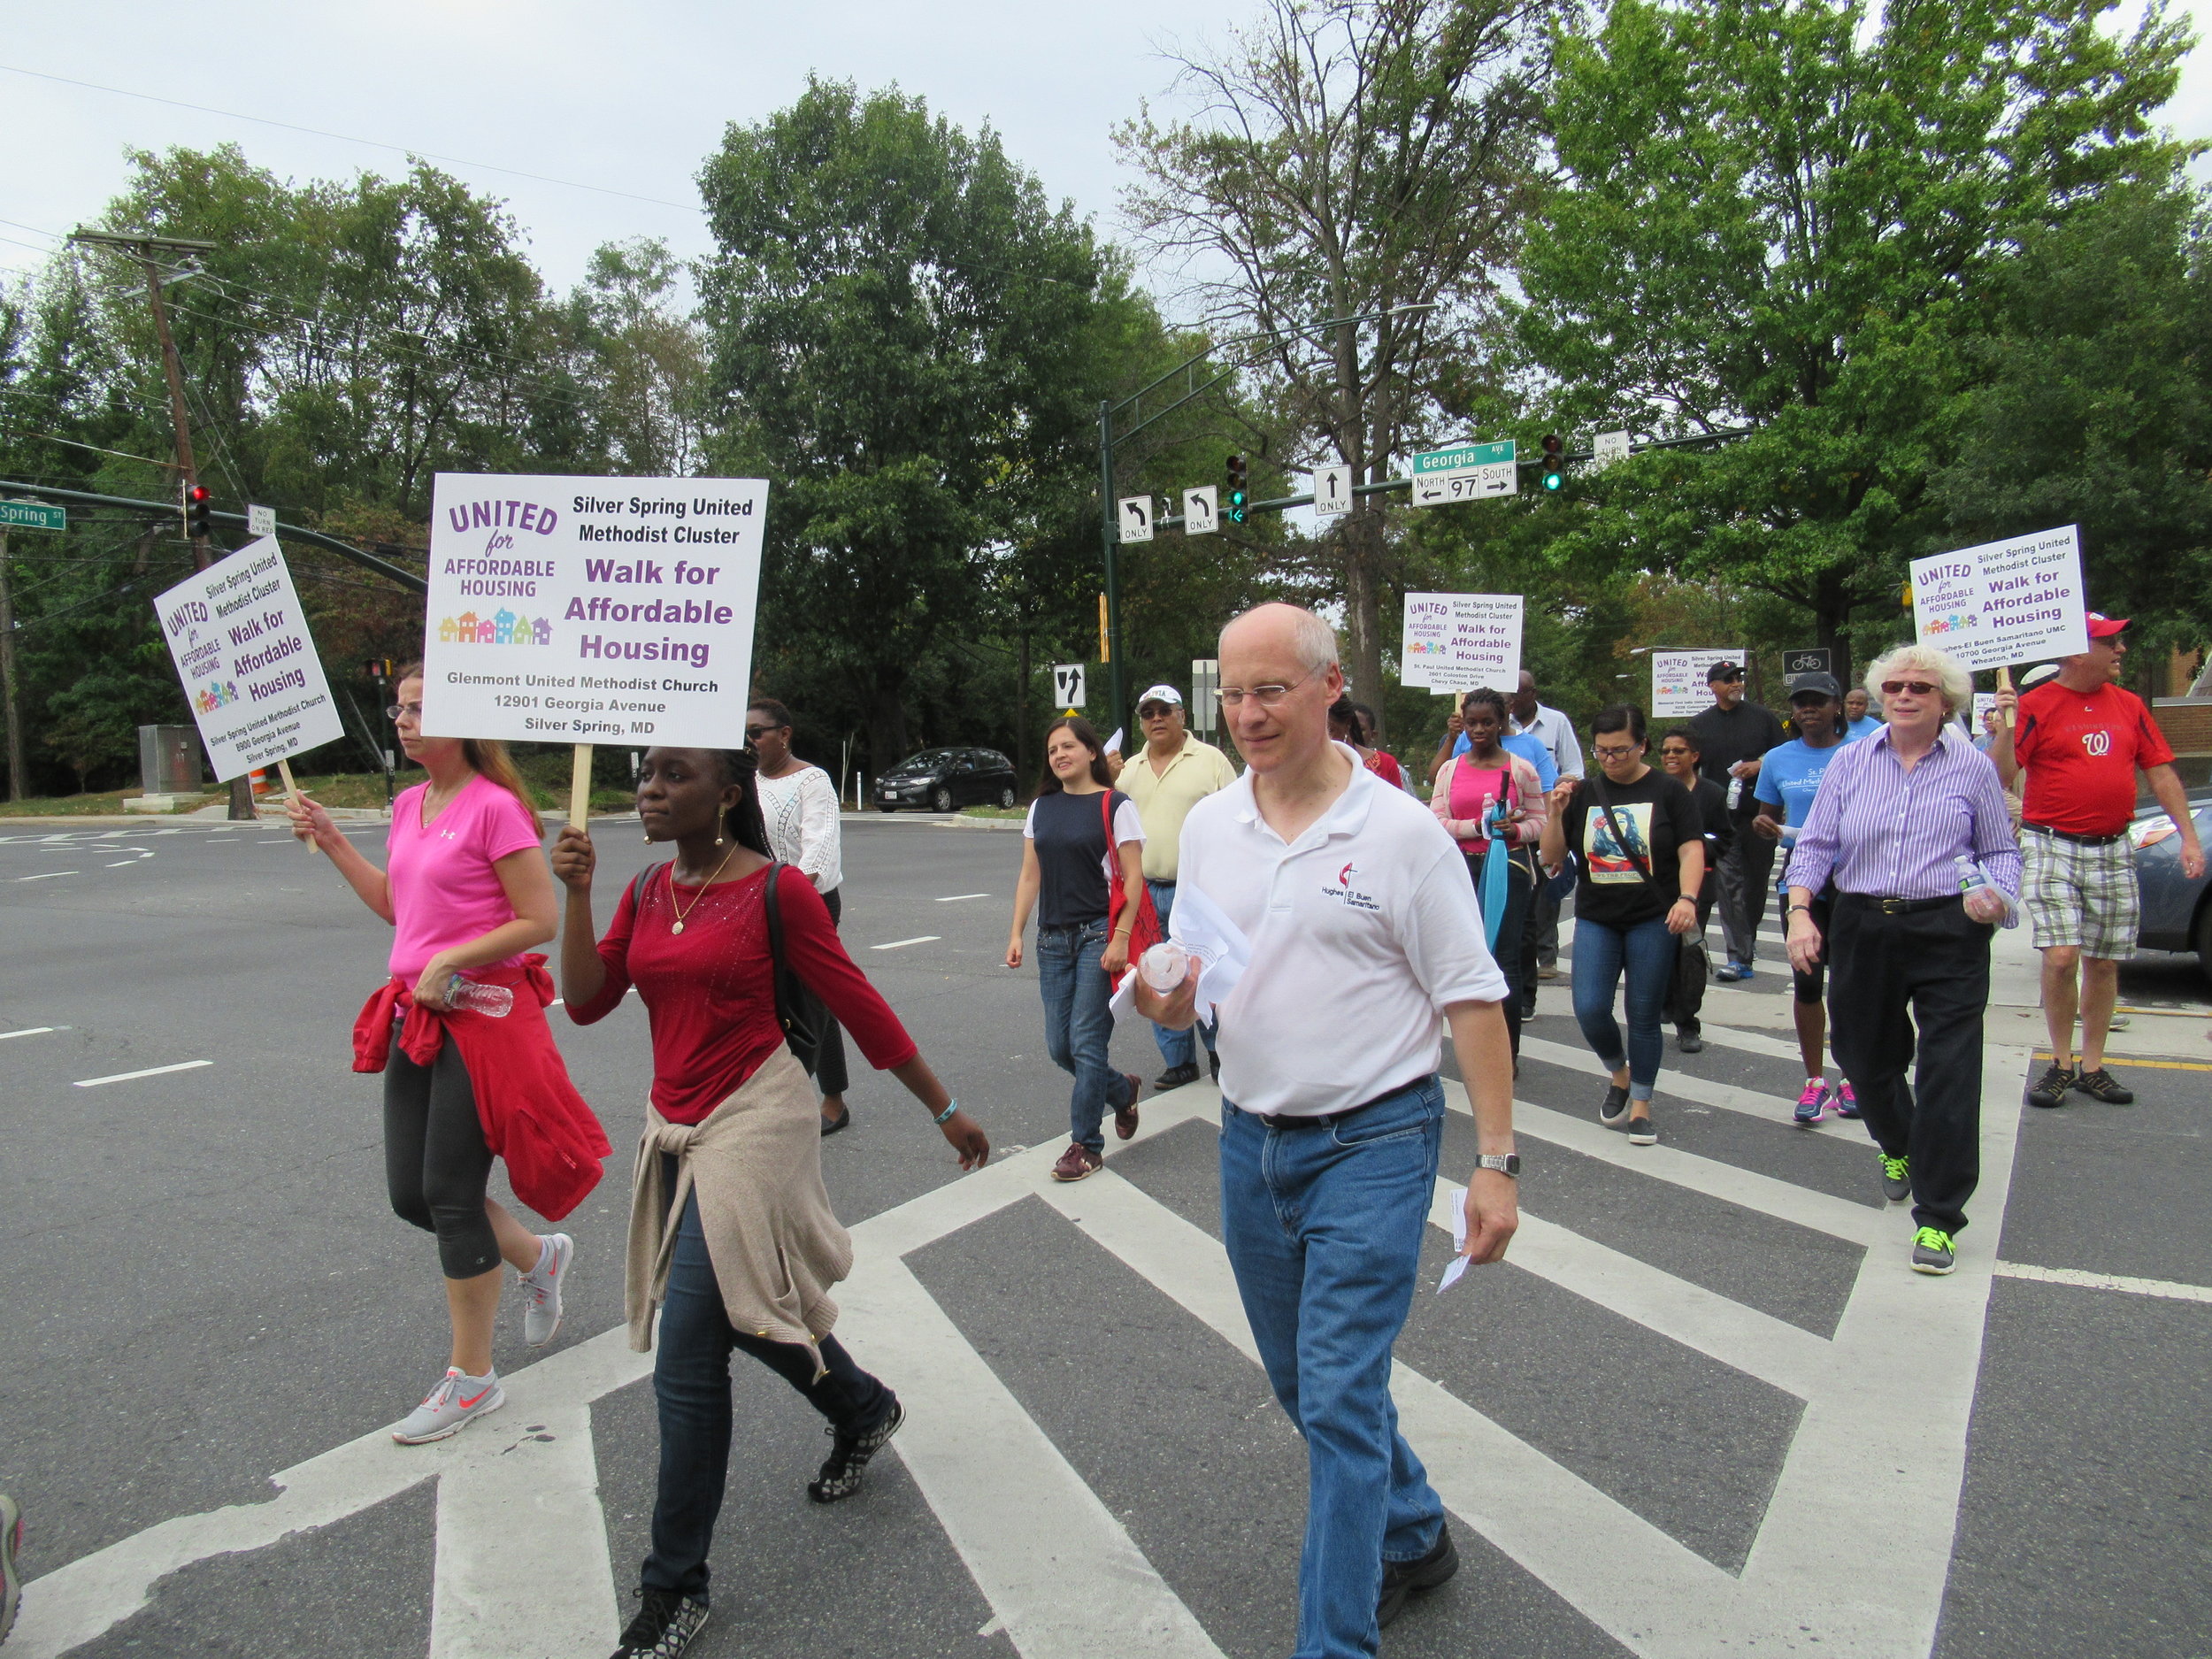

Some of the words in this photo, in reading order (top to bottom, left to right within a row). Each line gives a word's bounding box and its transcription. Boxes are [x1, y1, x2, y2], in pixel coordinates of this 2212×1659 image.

[1423, 450, 1474, 469] Georgia
[1491, 444, 1504, 453] AVE
[1417, 476, 1445, 488] NORTH
[1451, 480, 1476, 497] 97
[1483, 468, 1512, 480] SOUTH
[1, 505, 47, 526] Spring
[572, 495, 624, 514] Silver
[629, 496, 687, 519] Spring
[693, 498, 753, 516] United
[1320, 500, 1347, 512] ONLY
[449, 500, 558, 535] UNITED
[1190, 518, 1213, 530] ONLY
[485, 529, 514, 557] for
[579, 524, 668, 543] Methodist
[673, 526, 741, 544] Cluster
[1125, 528, 1148, 539] ONLY
[1978, 550, 2003, 564] Silver
[2006, 543, 2036, 557] Spring
[2039, 536, 2070, 550] United
[444, 558, 555, 577] AFFORDABLE
[585, 558, 664, 584] Walk
[674, 560, 720, 585] for
[1983, 560, 2029, 576] Methodist
[2032, 551, 2066, 566] Cluster
[205, 580, 227, 599] Silver
[227, 569, 252, 588] Spring
[250, 552, 278, 576] United
[1918, 564, 1971, 586] UNITED
[1988, 575, 2030, 594] Walk
[2034, 570, 2060, 585] for
[460, 580, 537, 597] HOUSING
[1920, 588, 1974, 606] AFFORDABLE
[1938, 580, 1952, 593] for
[216, 594, 253, 618] Methodist
[252, 579, 281, 601] Cluster
[1409, 603, 1448, 616] UNITED
[1929, 598, 1966, 613] HOUSING
[1982, 586, 2070, 613] Affordable
[167, 601, 209, 637] UNITED
[564, 596, 733, 625] Affordable
[1422, 613, 1432, 623] for
[1993, 607, 2062, 629] Housing
[188, 626, 199, 648] for
[228, 618, 264, 647] Walk
[264, 609, 285, 631] for
[1457, 624, 1486, 634] Walk
[1489, 624, 1506, 634] for
[1943, 641, 1971, 653] ghes-El
[1974, 638, 1994, 647] Buen
[1996, 630, 2044, 643] Samaritano
[2046, 625, 2067, 634] UMC
[180, 638, 221, 668] AFFORDABLE
[580, 634, 710, 668] Housing
[1451, 637, 1511, 648] Affordable
[1955, 649, 1979, 659] 10700
[1981, 644, 2013, 657] Georgia
[2016, 638, 2047, 649] Avenue
[234, 635, 303, 678] Affordable
[1455, 650, 1503, 664] Housing
[1656, 658, 1688, 668] UNITED
[1970, 654, 2008, 665] Wheaton,
[190, 657, 220, 680] HOUSING
[249, 667, 306, 702] Housing
[447, 671, 520, 687] Glenmont
[526, 673, 575, 689] United
[580, 676, 657, 691] Methodist
[663, 679, 718, 693] Church
[494, 695, 539, 709] 12901
[544, 696, 604, 713] Georgia
[609, 700, 666, 713] Avenue
[211, 733, 227, 747] Silver
[227, 724, 248, 740] Spring
[248, 717, 268, 732] United
[268, 705, 301, 724] Methodist
[301, 694, 326, 710] Church
[525, 718, 568, 731] Silver
[572, 718, 626, 735] Spring,
[630, 721, 655, 734] MD
[235, 739, 251, 752] 8900
[251, 731, 276, 746] Georgia
[277, 721, 301, 736] Avenue
[2081, 730, 2110, 757] W
[246, 750, 265, 764] Silver
[265, 741, 288, 757] Spring,
[287, 737, 298, 749] MD
[1322, 887, 1344, 896] Hughes
[1356, 893, 1371, 902] Buen
[1347, 898, 1380, 910] Samaritano
